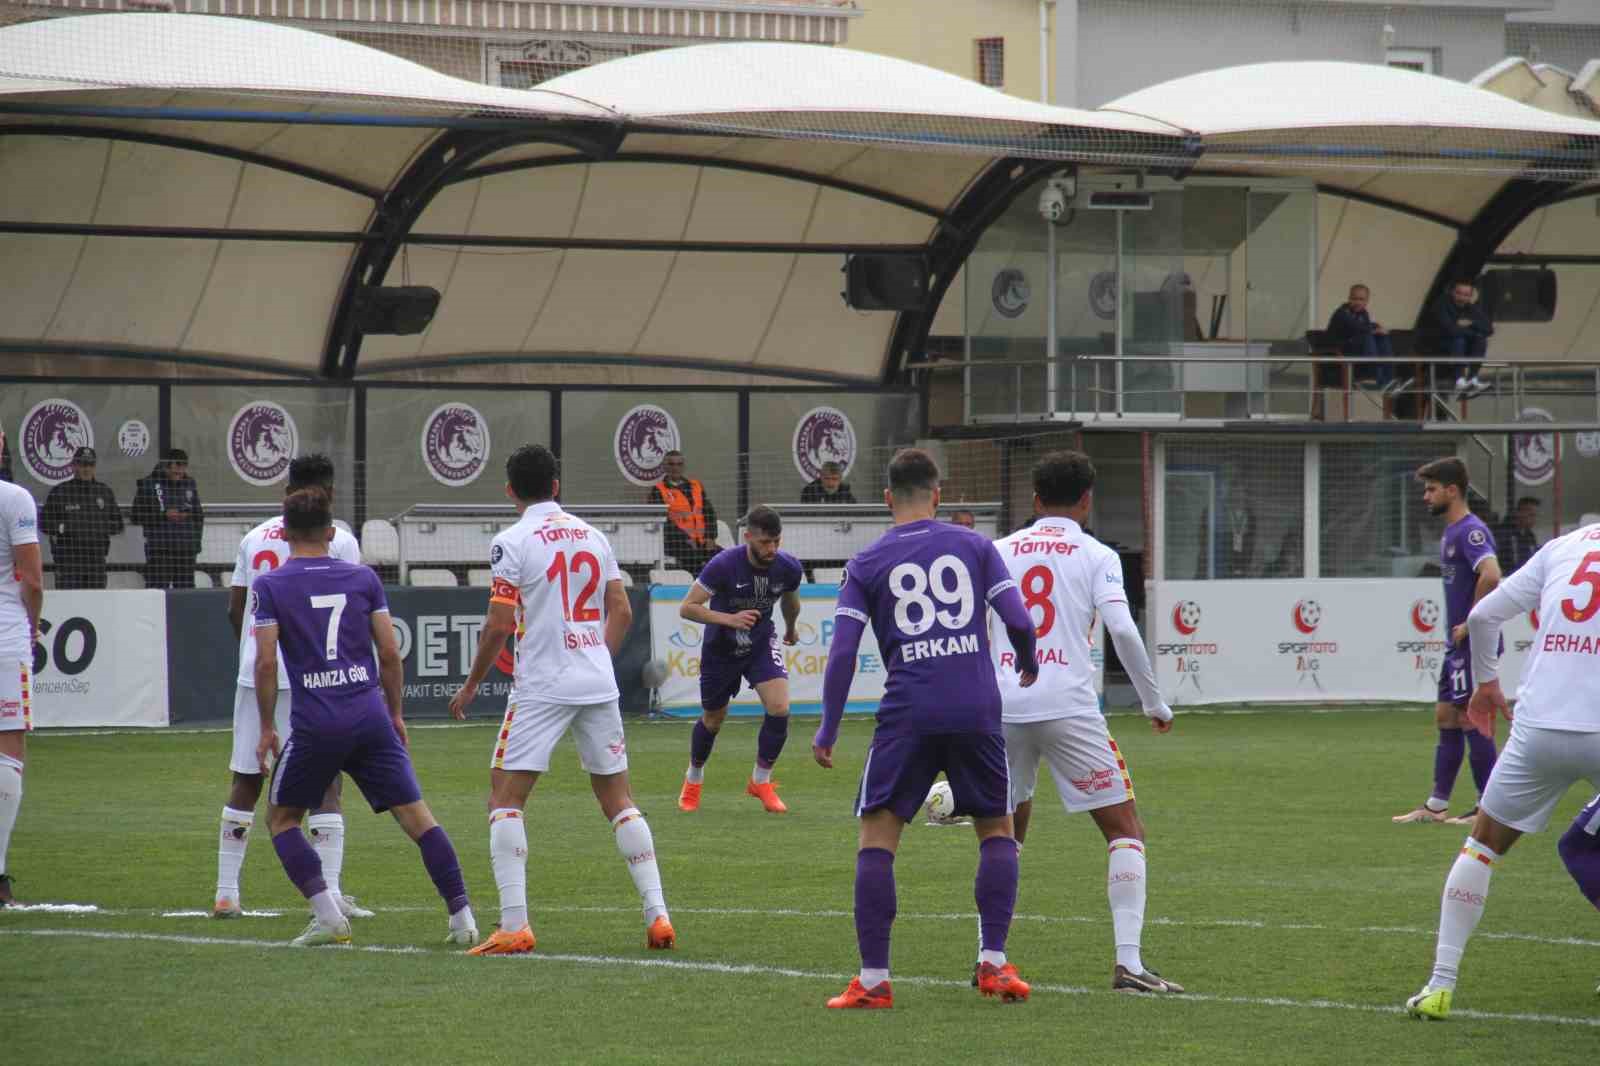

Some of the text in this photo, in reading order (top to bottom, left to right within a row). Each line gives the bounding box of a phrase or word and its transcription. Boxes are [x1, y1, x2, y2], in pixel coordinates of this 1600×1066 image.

[546, 551, 601, 622] 12
[888, 554, 974, 636] 89
[1021, 565, 1056, 639] 8
[1562, 550, 1600, 622] 5
[310, 594, 347, 660] 7
[901, 634, 979, 663] ERKAM
[303, 664, 369, 689] HAMZA GÜR
[1451, 670, 1467, 692] 11
